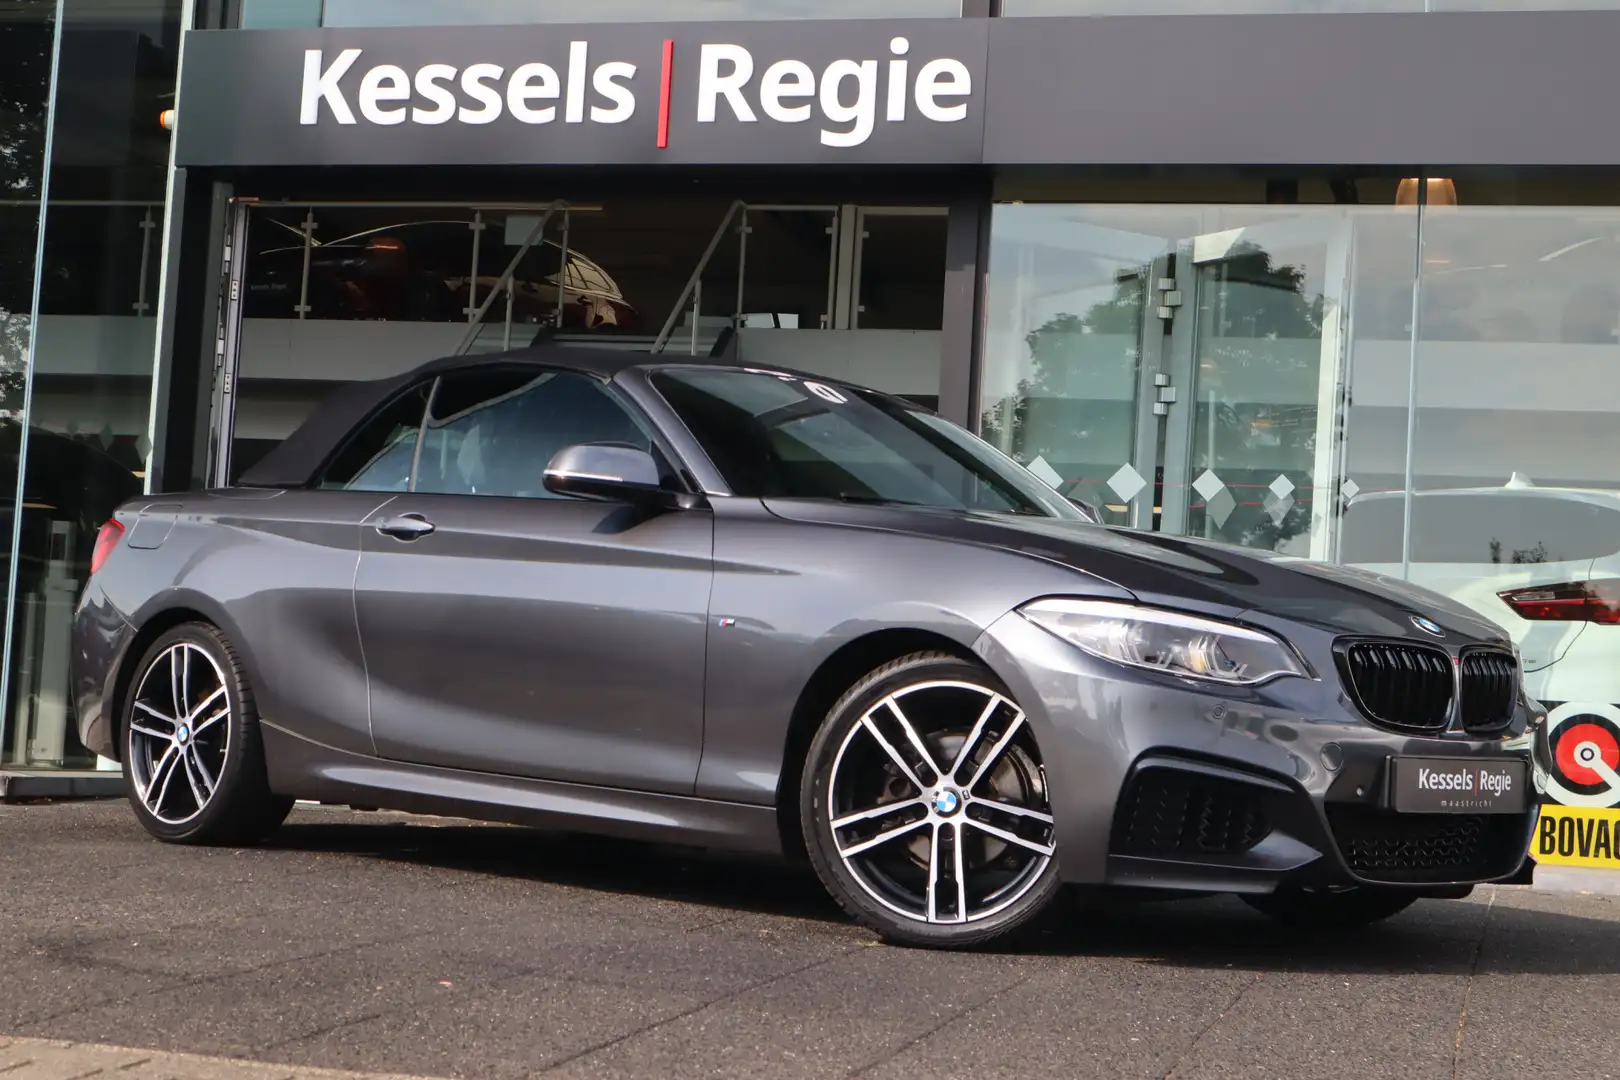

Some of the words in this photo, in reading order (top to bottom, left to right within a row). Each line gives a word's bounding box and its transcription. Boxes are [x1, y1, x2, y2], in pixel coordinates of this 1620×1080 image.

[299, 40, 637, 127] Kessels
[697, 37, 972, 148] Regie
[1418, 768, 1474, 791] Kessels
[1480, 770, 1512, 797] Regie
[1440, 799, 1493, 808] maastricht
